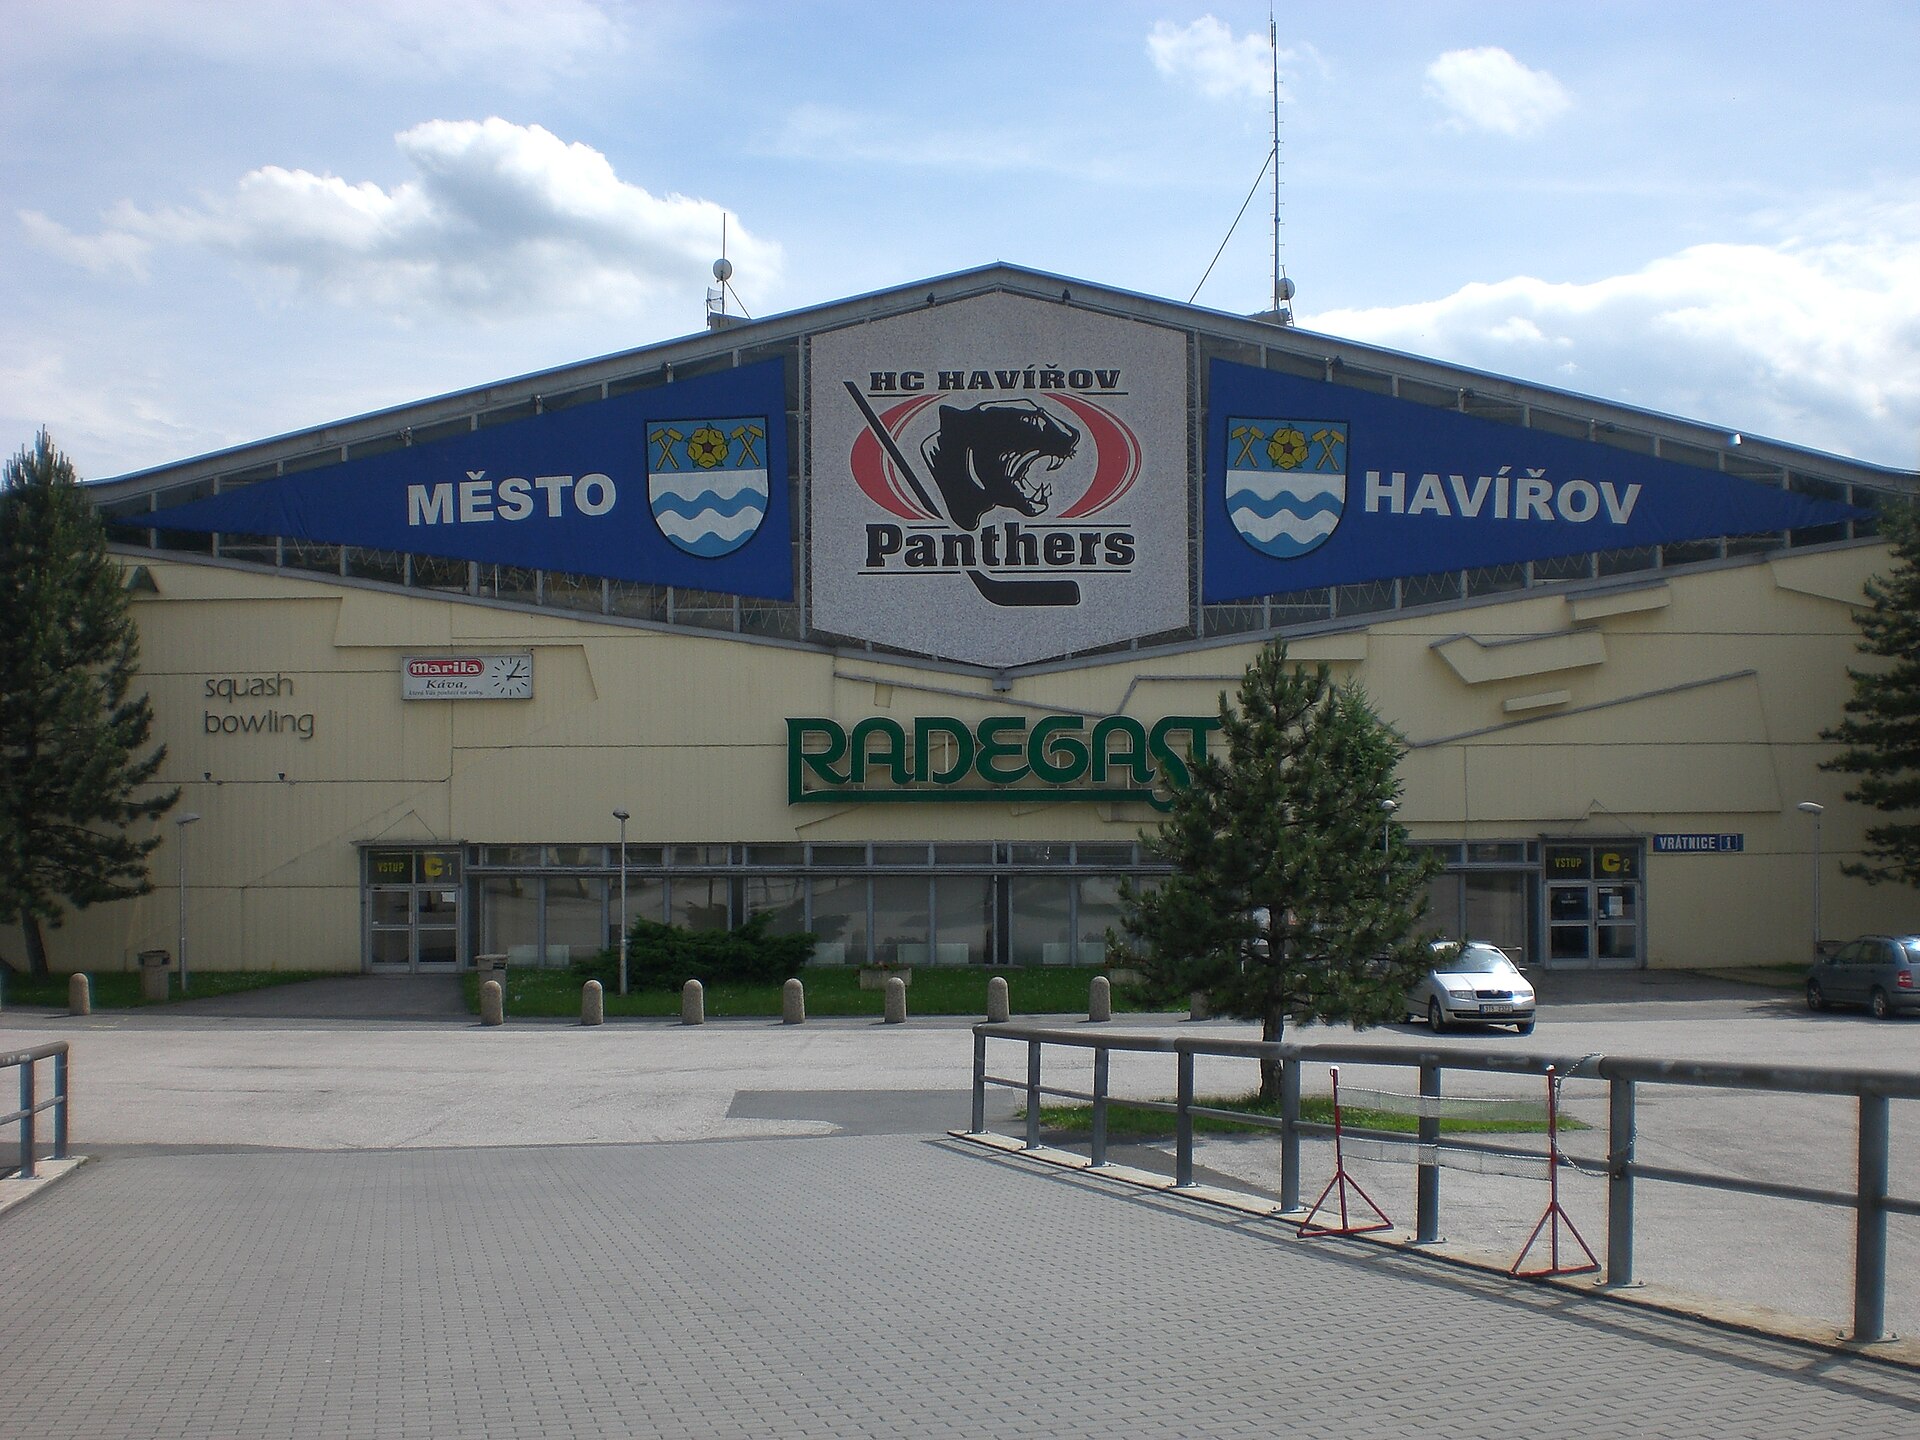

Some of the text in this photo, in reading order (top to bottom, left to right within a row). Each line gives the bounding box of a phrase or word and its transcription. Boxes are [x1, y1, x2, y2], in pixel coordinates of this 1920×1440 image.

[869, 363, 1121, 391] HC HAVÍŘOV
[407, 470, 617, 526] MĚSTO
[1365, 466, 1642, 524] HAVÍŘOV
[865, 522, 1136, 568] Panthers
[410, 662, 479, 674] marila
[205, 673, 293, 703] squash
[426, 680, 467, 689] Káva,
[205, 710, 314, 740] bowling
[1660, 835, 1715, 849] VRÁTNICE
[377, 862, 404, 872] VSTUP
[1555, 853, 1630, 872] VSTUP C 2
